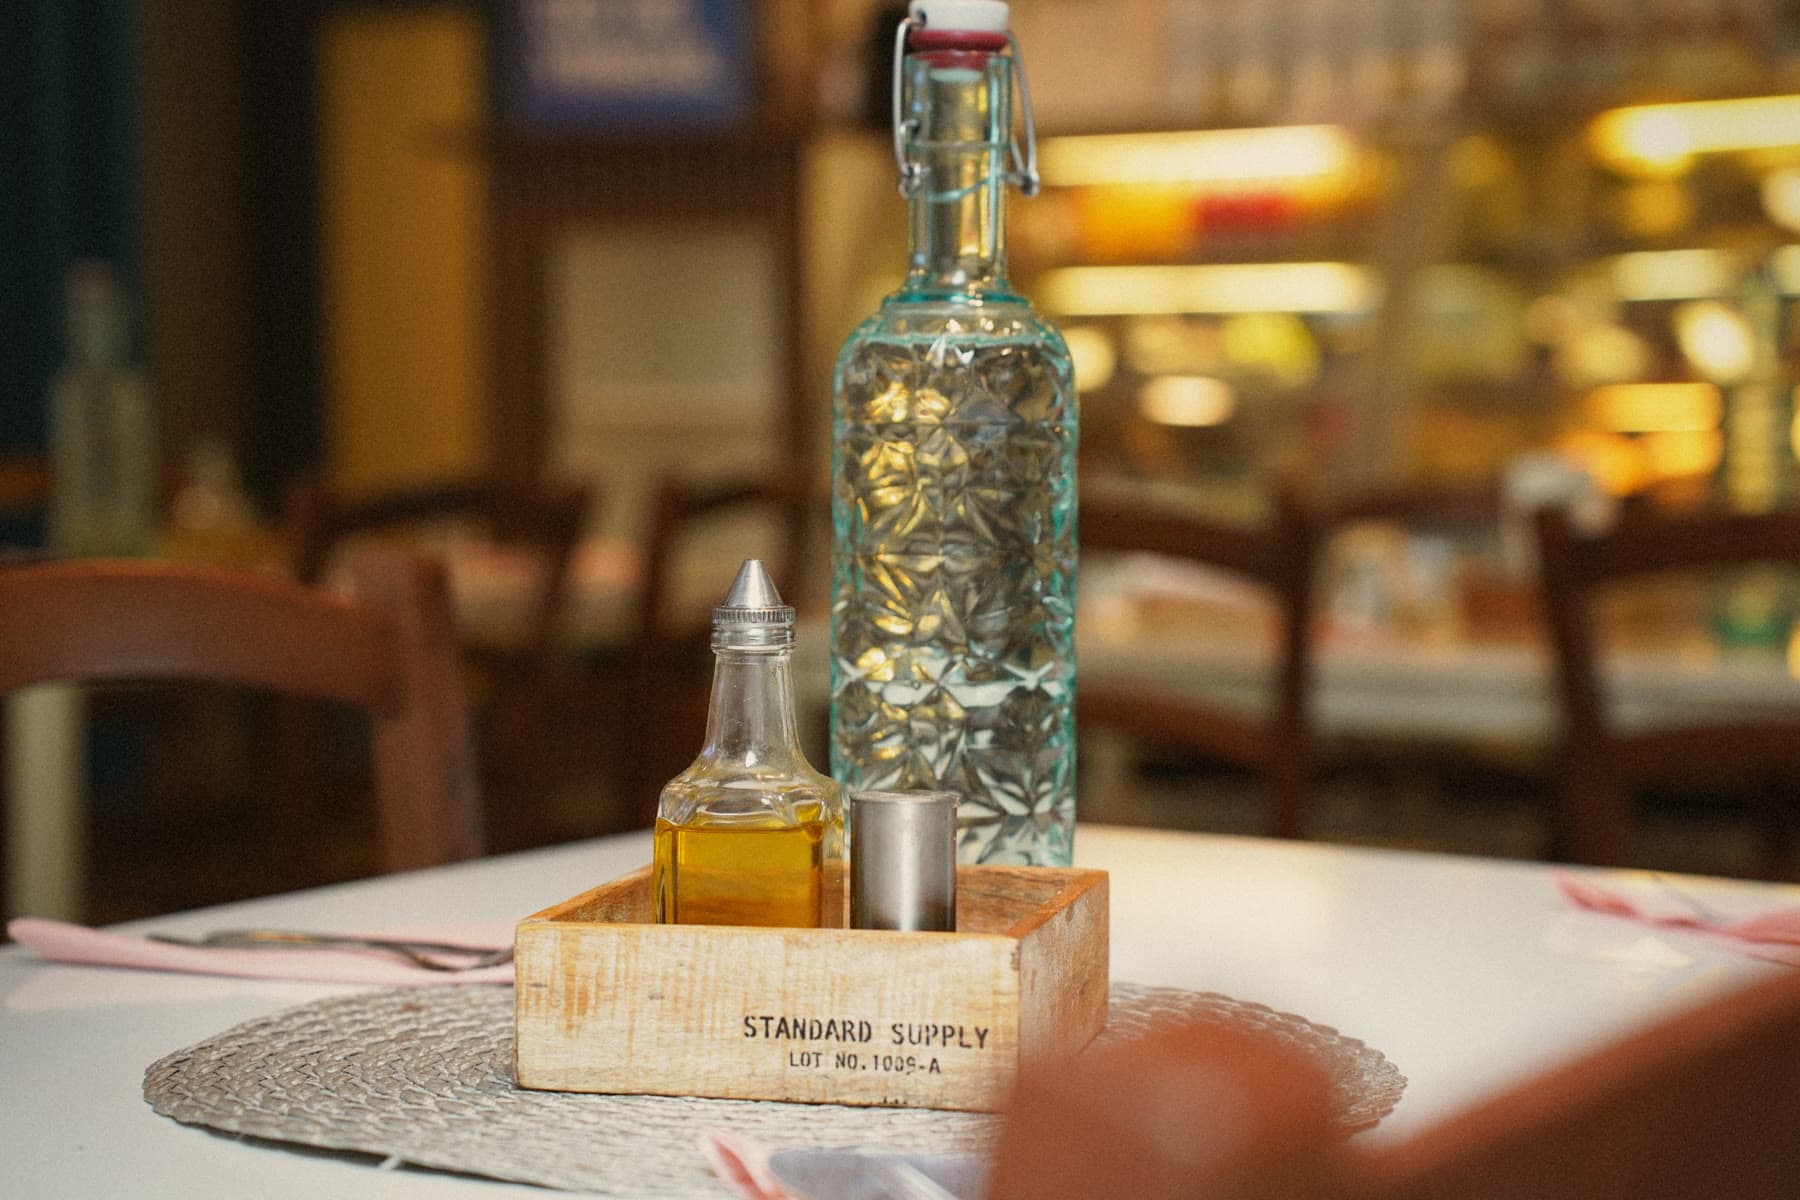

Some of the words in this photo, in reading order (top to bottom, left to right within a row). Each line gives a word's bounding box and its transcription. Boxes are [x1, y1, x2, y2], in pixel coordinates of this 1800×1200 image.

[744, 1015, 872, 1043] STANDARD
[891, 1023, 989, 1049] SUPPLY
[789, 1051, 823, 1068] LOT
